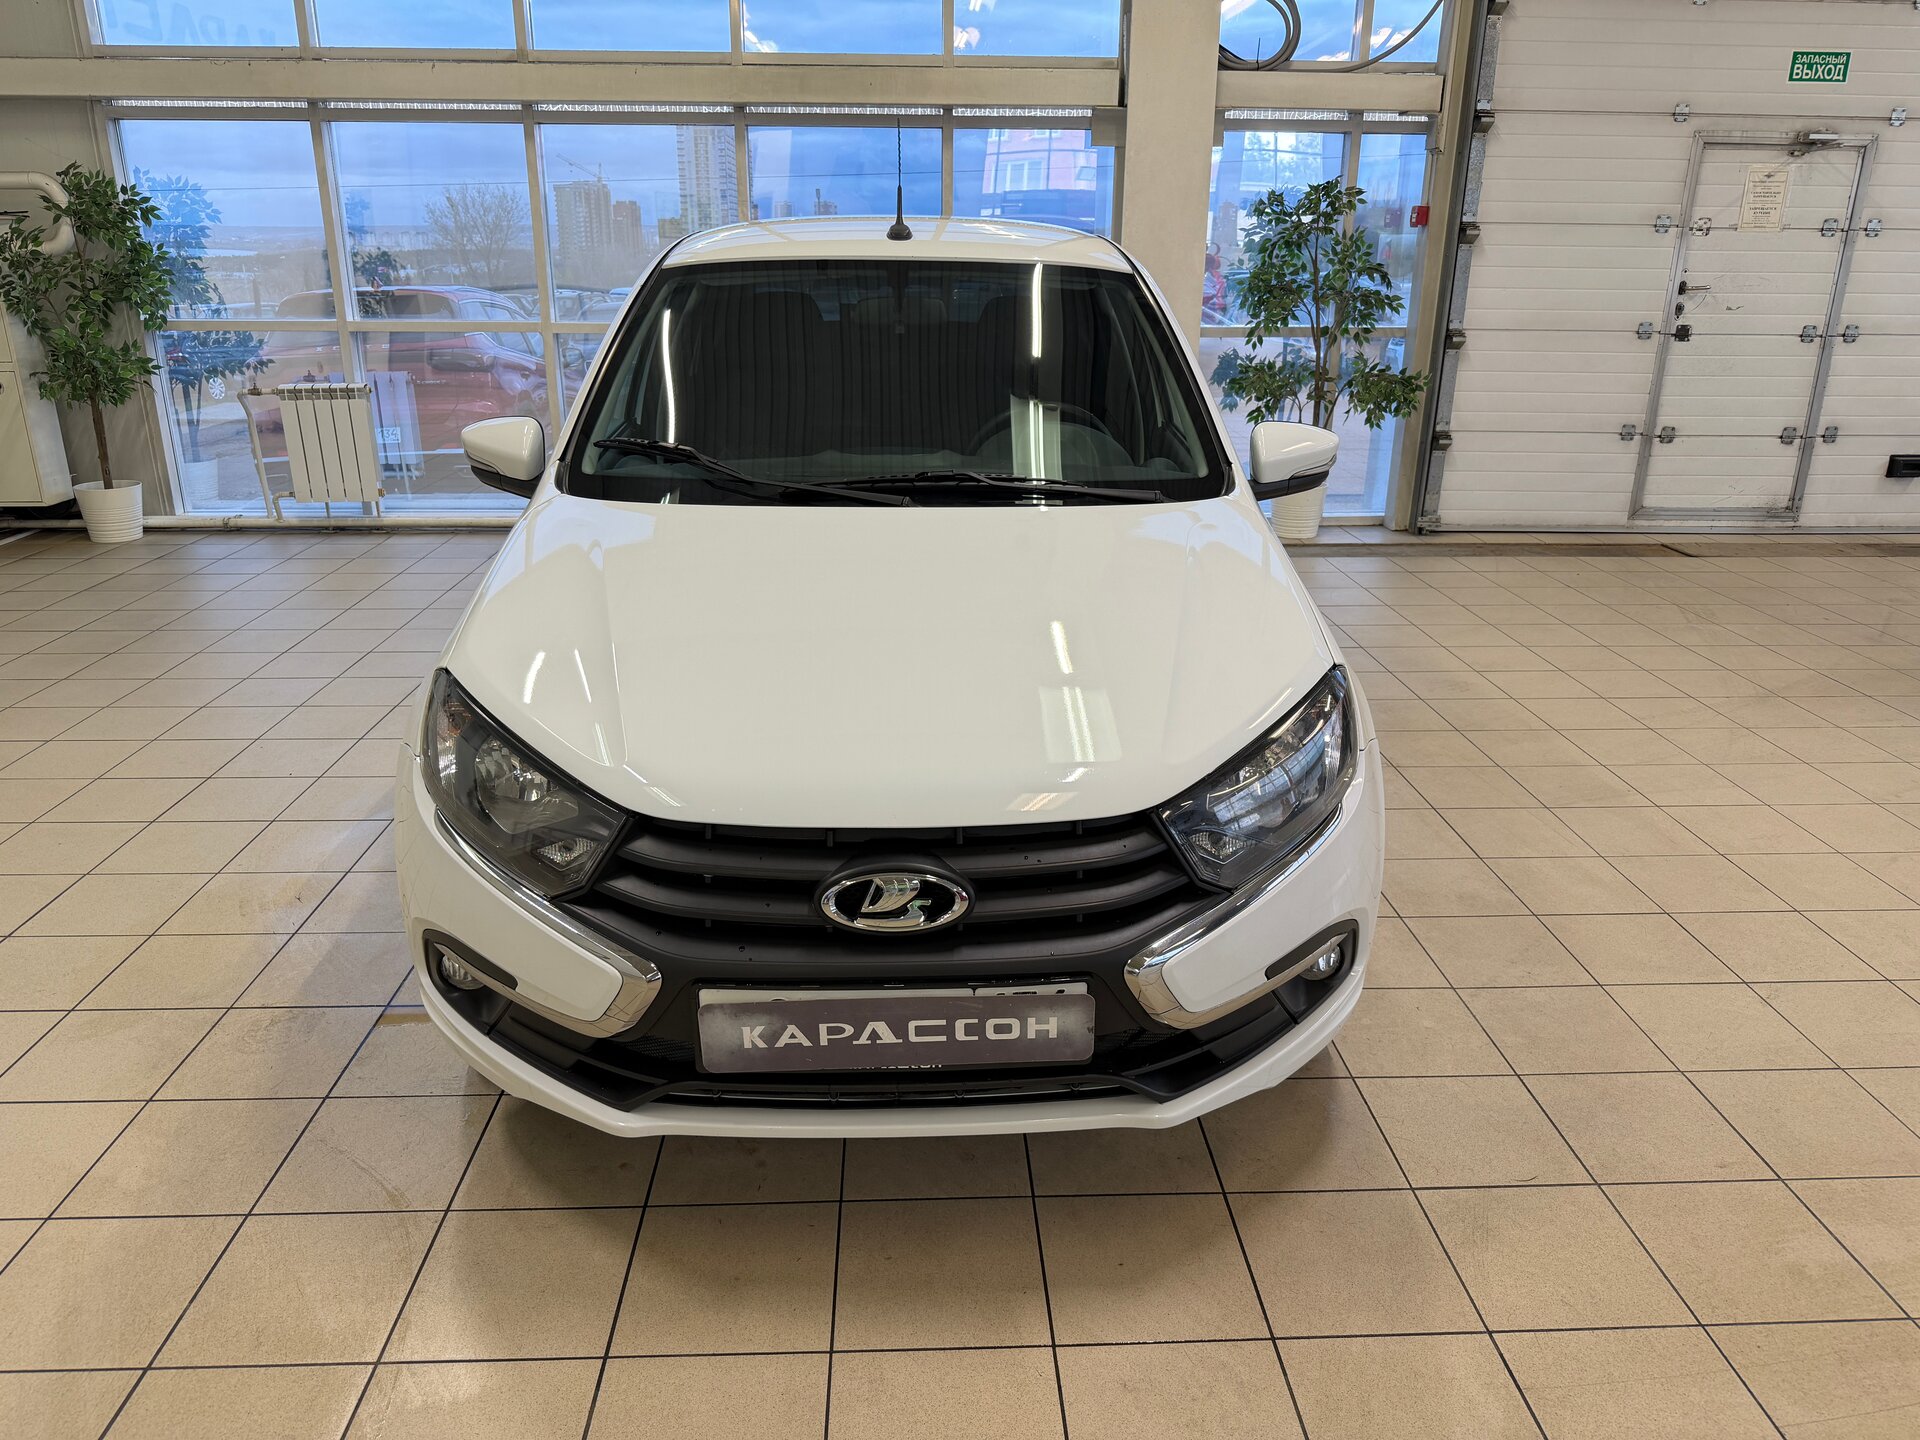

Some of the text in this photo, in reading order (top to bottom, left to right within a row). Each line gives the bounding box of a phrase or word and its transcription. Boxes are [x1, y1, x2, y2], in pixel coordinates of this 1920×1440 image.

[1795, 53, 1847, 64] ЗАПАСНЫЙ
[1792, 64, 1845, 80] ВЫХОД
[740, 1016, 1058, 1049] КАРАССОН
